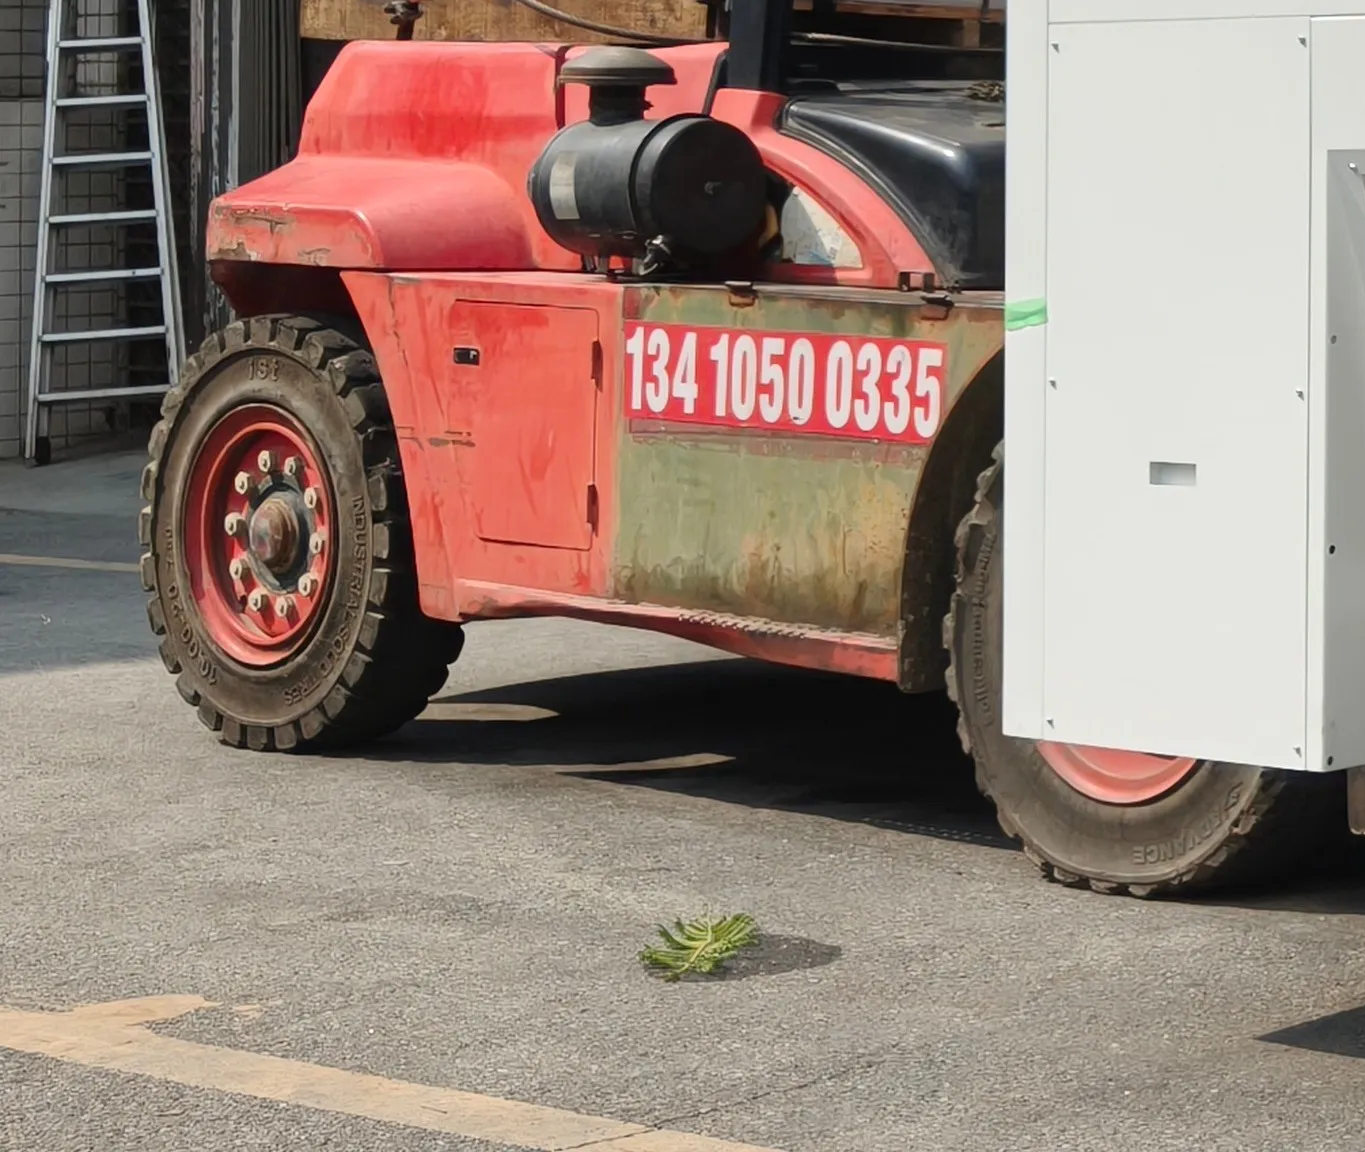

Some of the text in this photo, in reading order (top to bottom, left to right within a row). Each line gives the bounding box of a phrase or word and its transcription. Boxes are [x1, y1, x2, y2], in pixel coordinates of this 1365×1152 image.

[626, 326, 944, 438] 134 1050 0335
